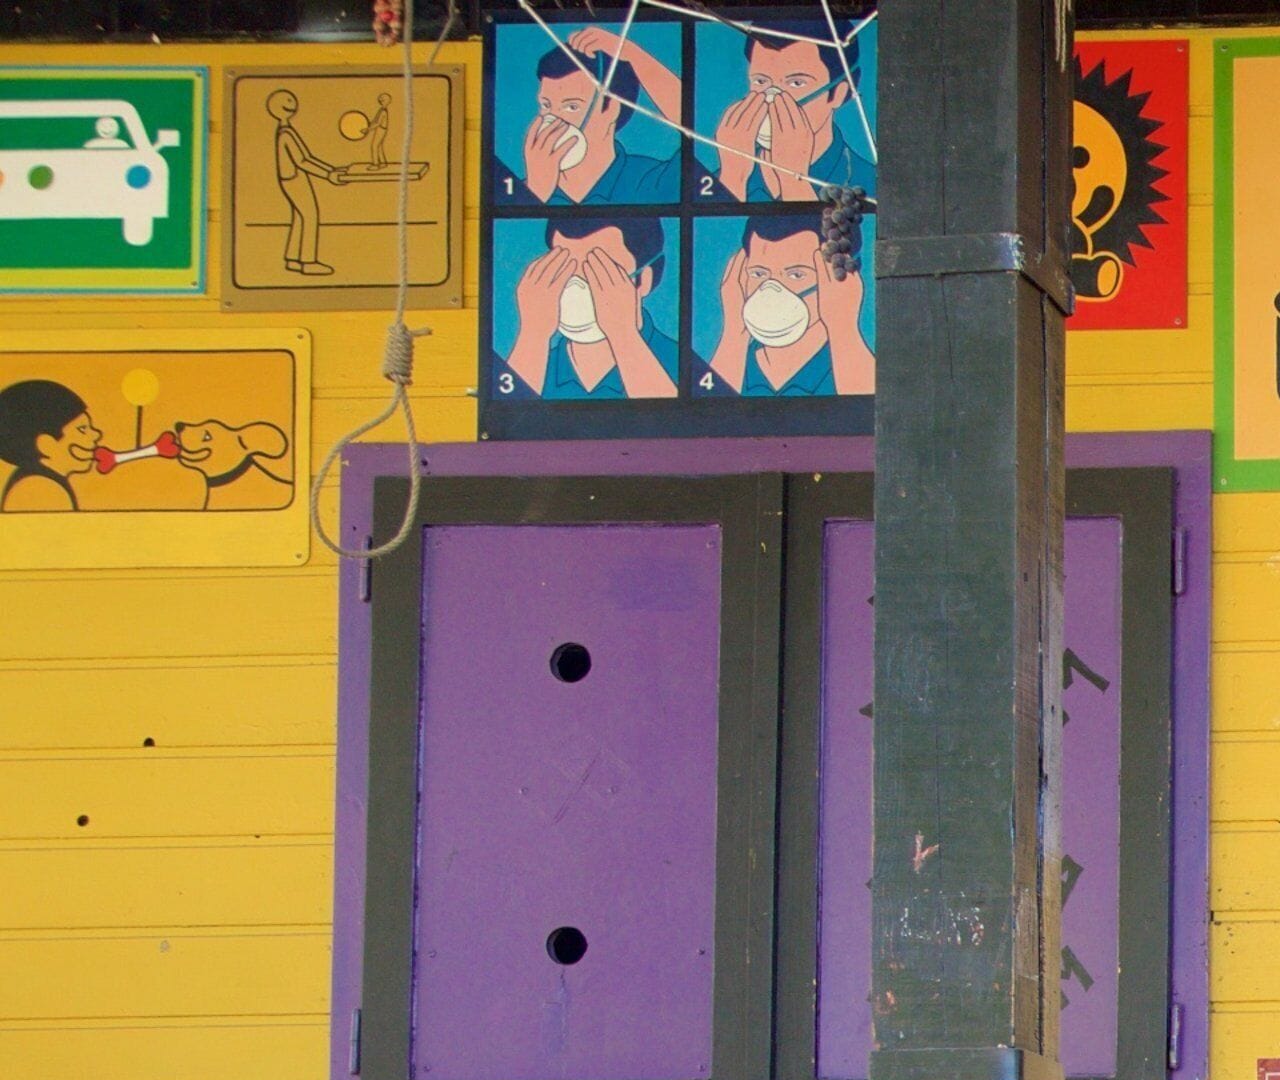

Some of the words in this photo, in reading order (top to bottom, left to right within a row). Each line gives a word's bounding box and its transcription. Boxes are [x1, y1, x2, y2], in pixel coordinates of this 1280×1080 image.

[504, 178, 514, 195] 1
[700, 177, 714, 195] 2
[499, 373, 515, 394] 3
[698, 372, 714, 391] 4
